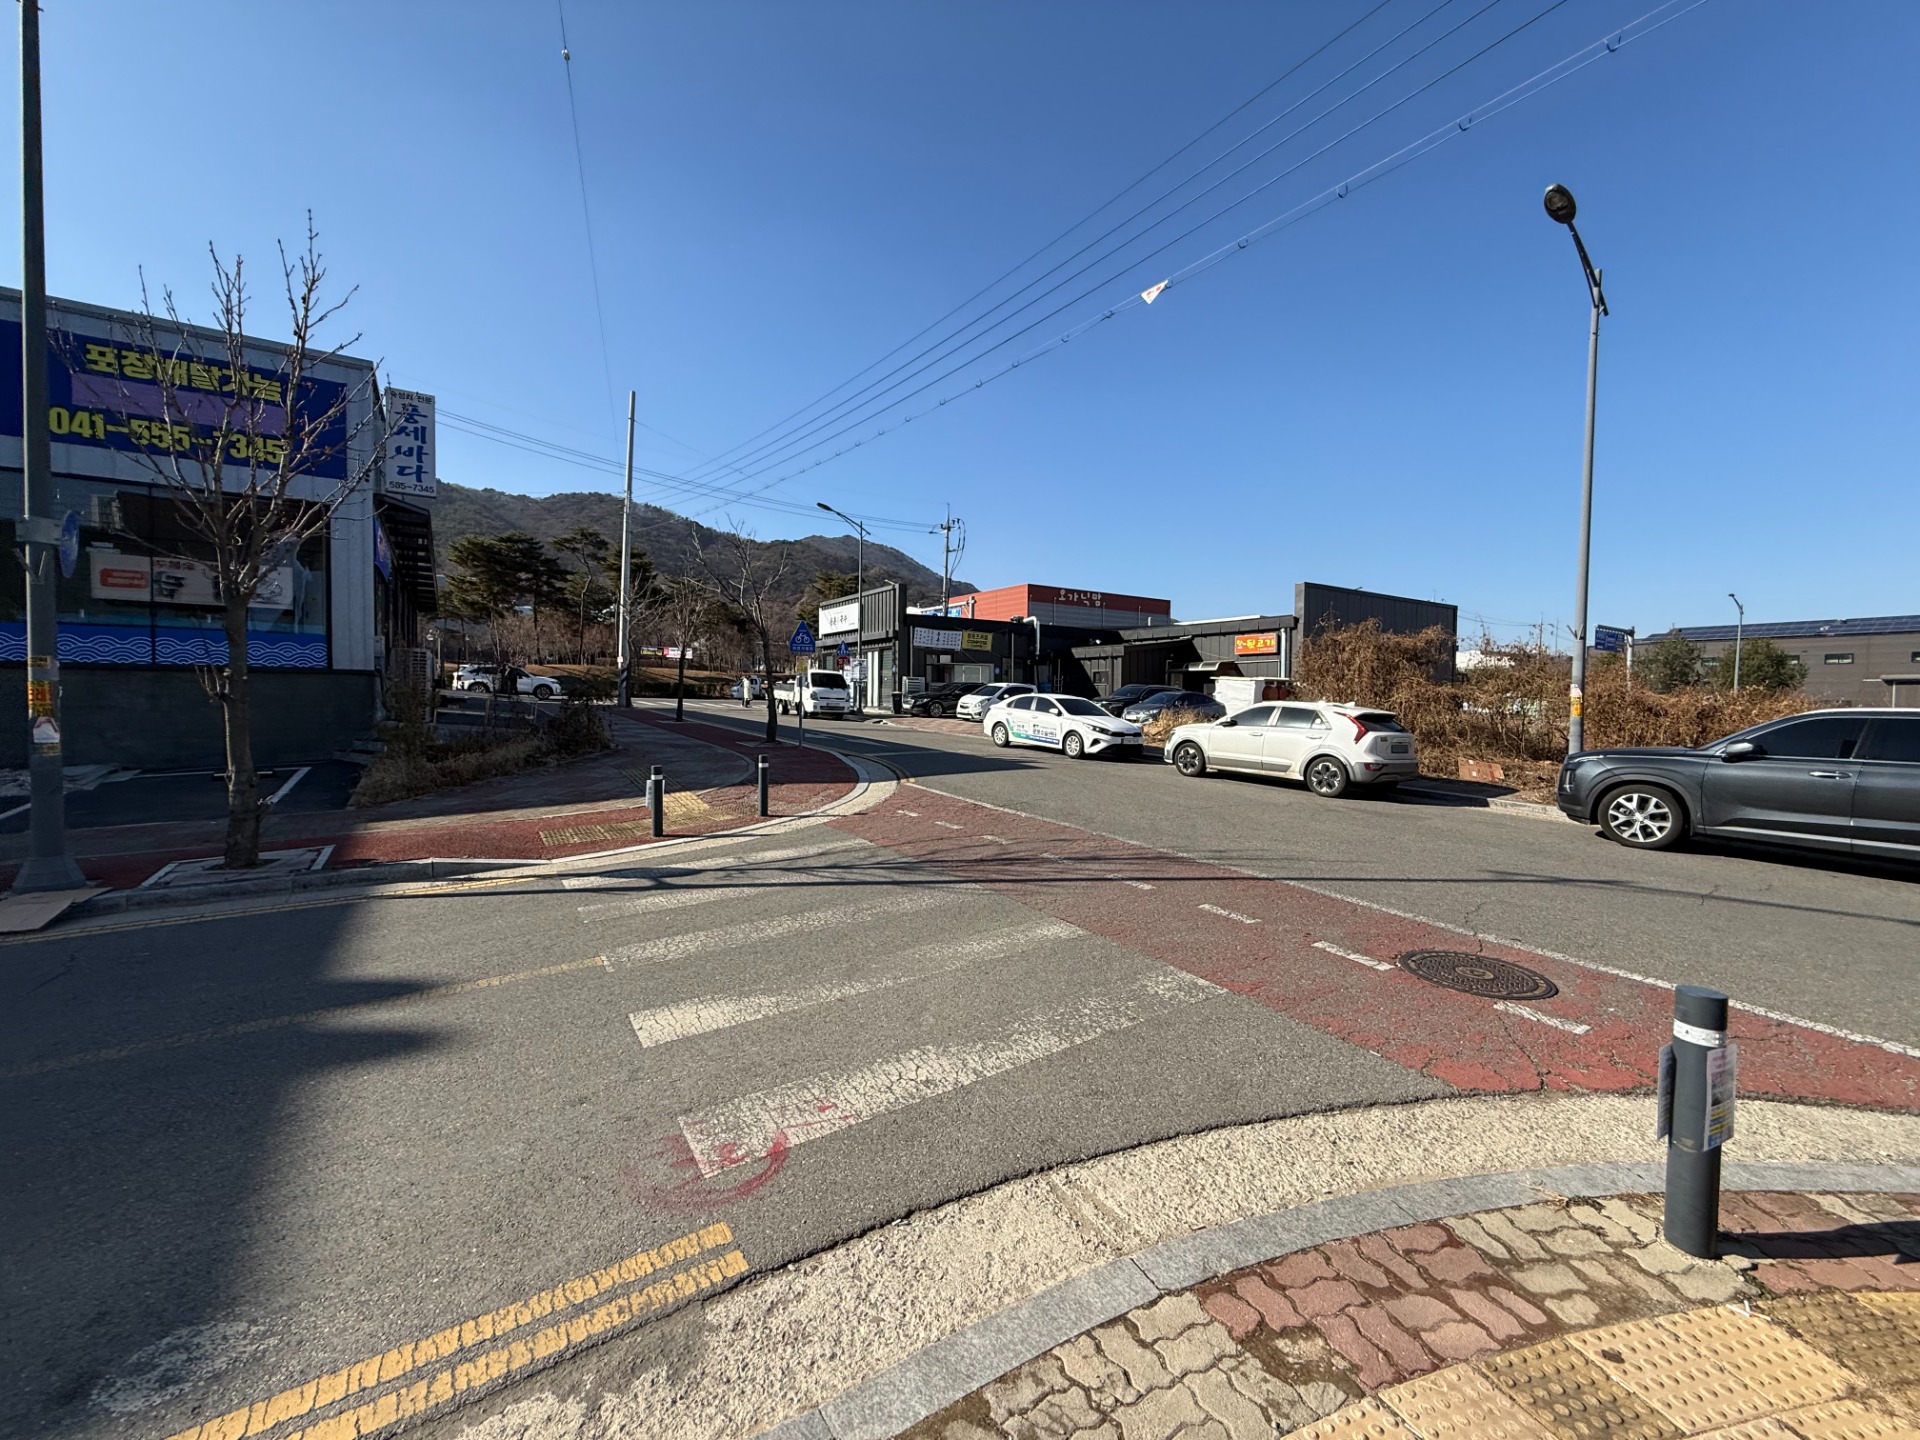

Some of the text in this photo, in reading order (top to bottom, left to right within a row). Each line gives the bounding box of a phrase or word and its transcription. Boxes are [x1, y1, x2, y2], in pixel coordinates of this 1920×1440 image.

[85, 343, 282, 402] 포장배달가능
[393, 402, 430, 483] 풍세바다
[1058, 589, 1103, 607] 오가닉맘
